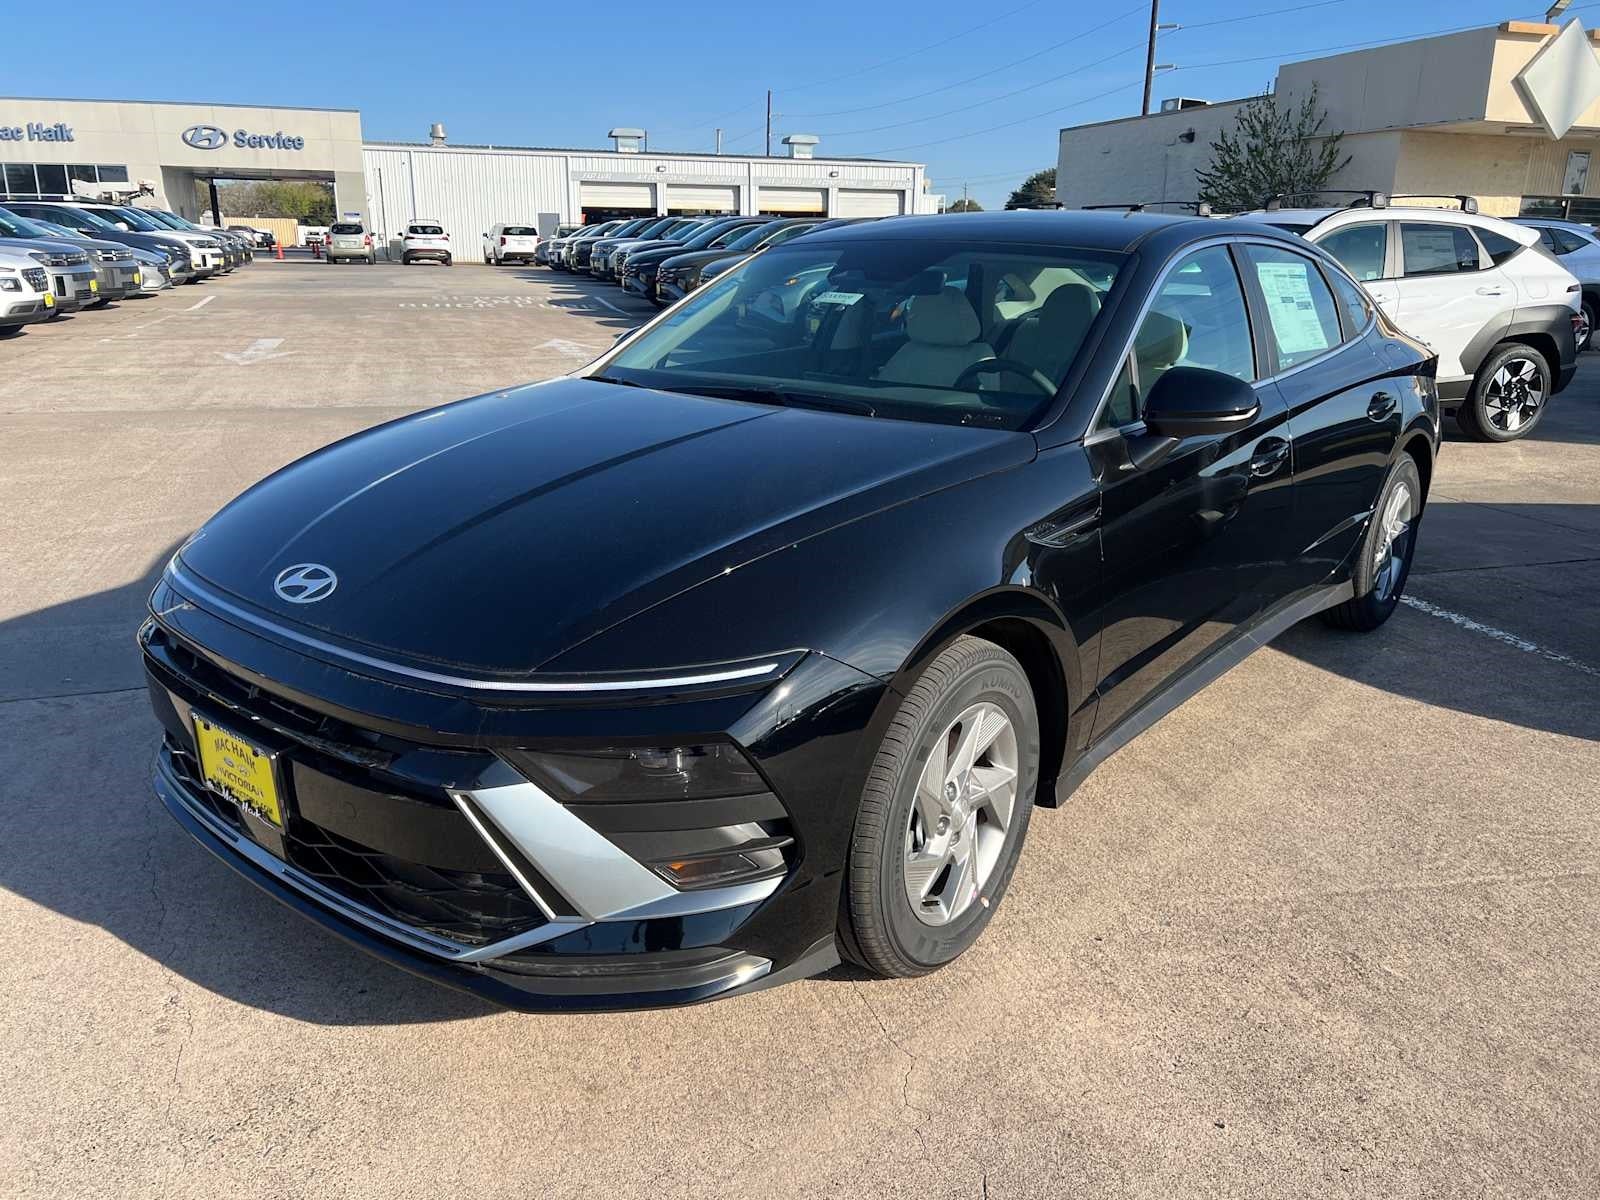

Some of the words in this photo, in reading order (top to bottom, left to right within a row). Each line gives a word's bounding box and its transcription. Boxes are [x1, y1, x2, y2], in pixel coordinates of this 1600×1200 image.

[0, 126, 24, 141] ac
[27, 122, 74, 141] Haik
[233, 129, 304, 150] Service
